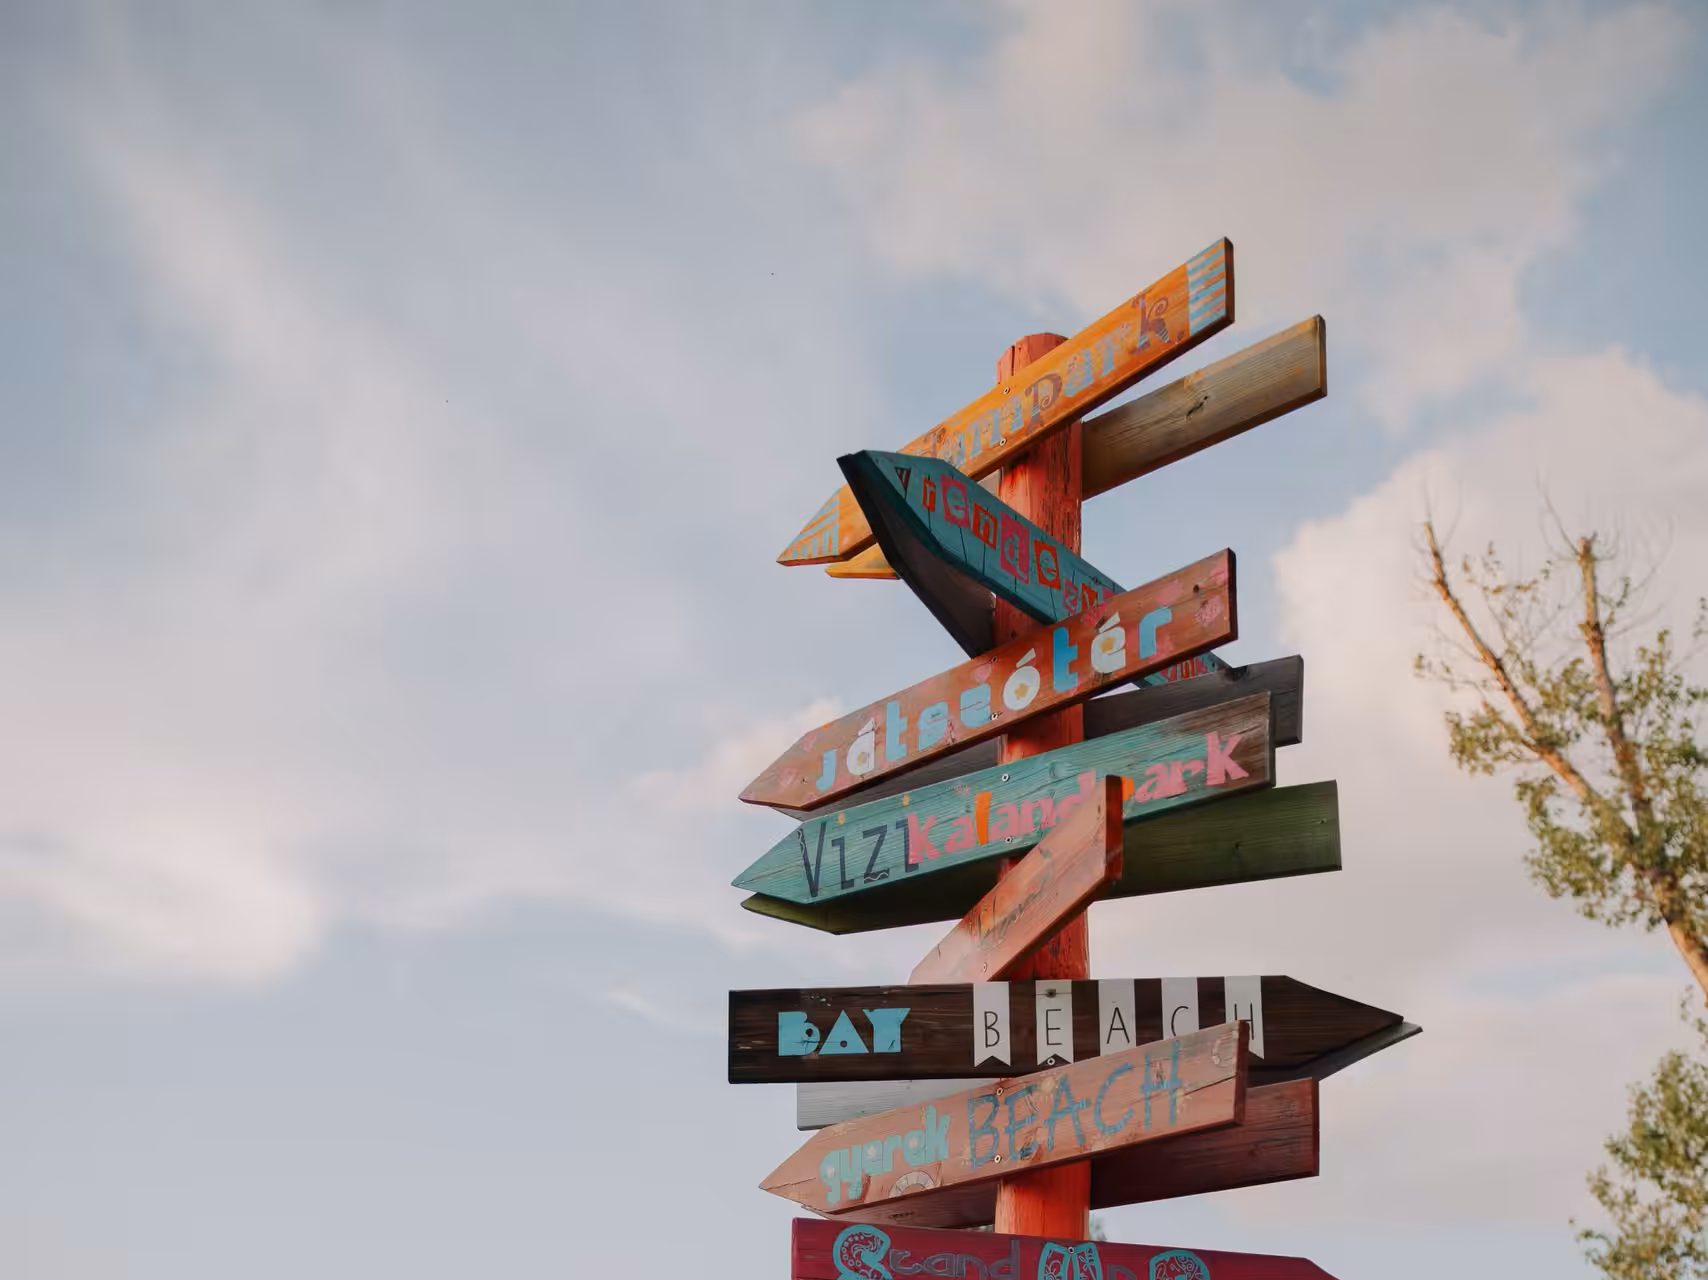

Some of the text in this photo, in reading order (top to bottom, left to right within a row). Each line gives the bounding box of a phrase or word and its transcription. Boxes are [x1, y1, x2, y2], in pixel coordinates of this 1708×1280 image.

[778, 1001, 1255, 1057] BAY BEACH
[967, 1039, 1183, 1171] BEACH
